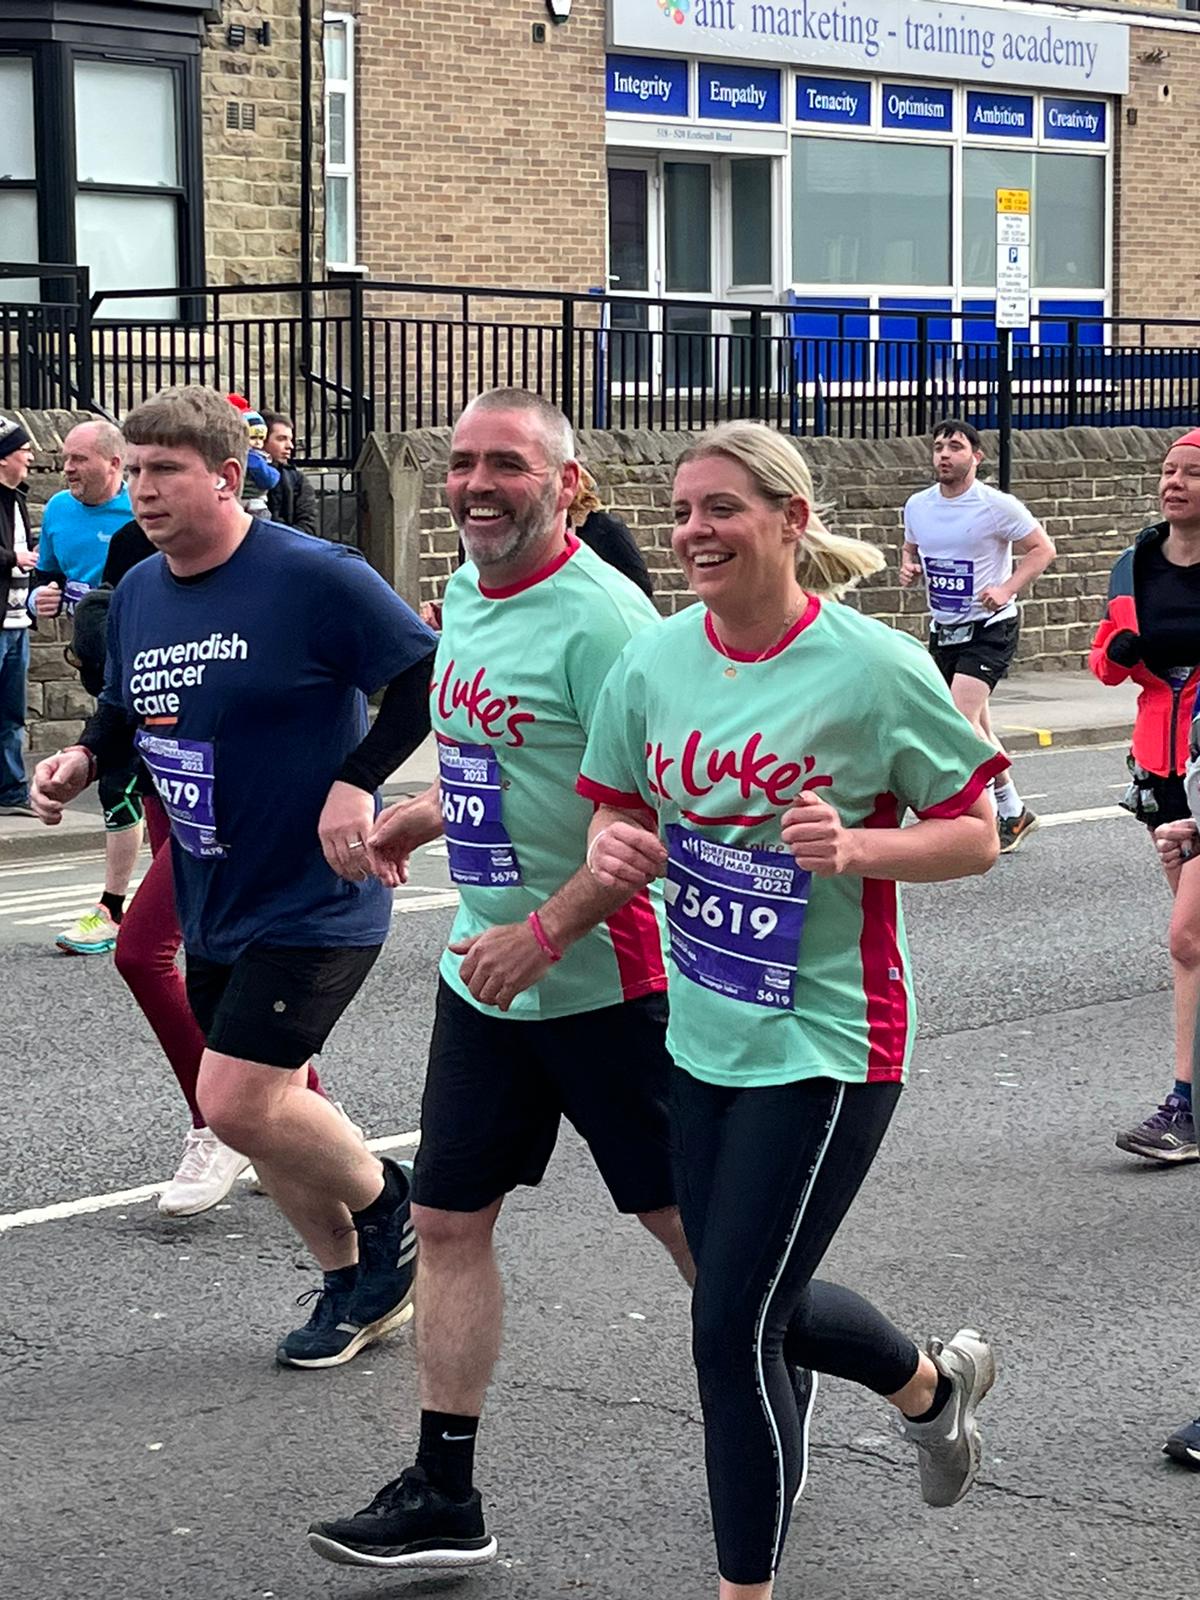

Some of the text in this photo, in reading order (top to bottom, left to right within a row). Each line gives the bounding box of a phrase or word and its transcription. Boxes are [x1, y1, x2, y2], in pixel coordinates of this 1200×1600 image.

[752, 0, 880, 57] marketing
[906, 13, 995, 68] training
[1003, 26, 1098, 79] academy
[614, 71, 672, 102] Integrity
[710, 81, 767, 110] Empathy
[806, 89, 858, 117] Tenacity
[888, 94, 944, 119] Optimism
[974, 105, 1025, 127] Ambition
[1049, 108, 1099, 133] Creativity
[133, 632, 249, 671] cavendish
[129, 664, 206, 694] cancer
[133, 692, 180, 715] care
[438, 659, 536, 748] Luke's
[462, 769, 488, 783] 2023
[152, 774, 200, 809] 479
[701, 842, 750, 862] SHEFFIELD
[490, 870, 519, 883] 5679
[726, 860, 793, 880] MARATHON
[753, 877, 793, 895] 2023
[682, 884, 778, 940] 5619
[756, 989, 790, 1005] 5619
